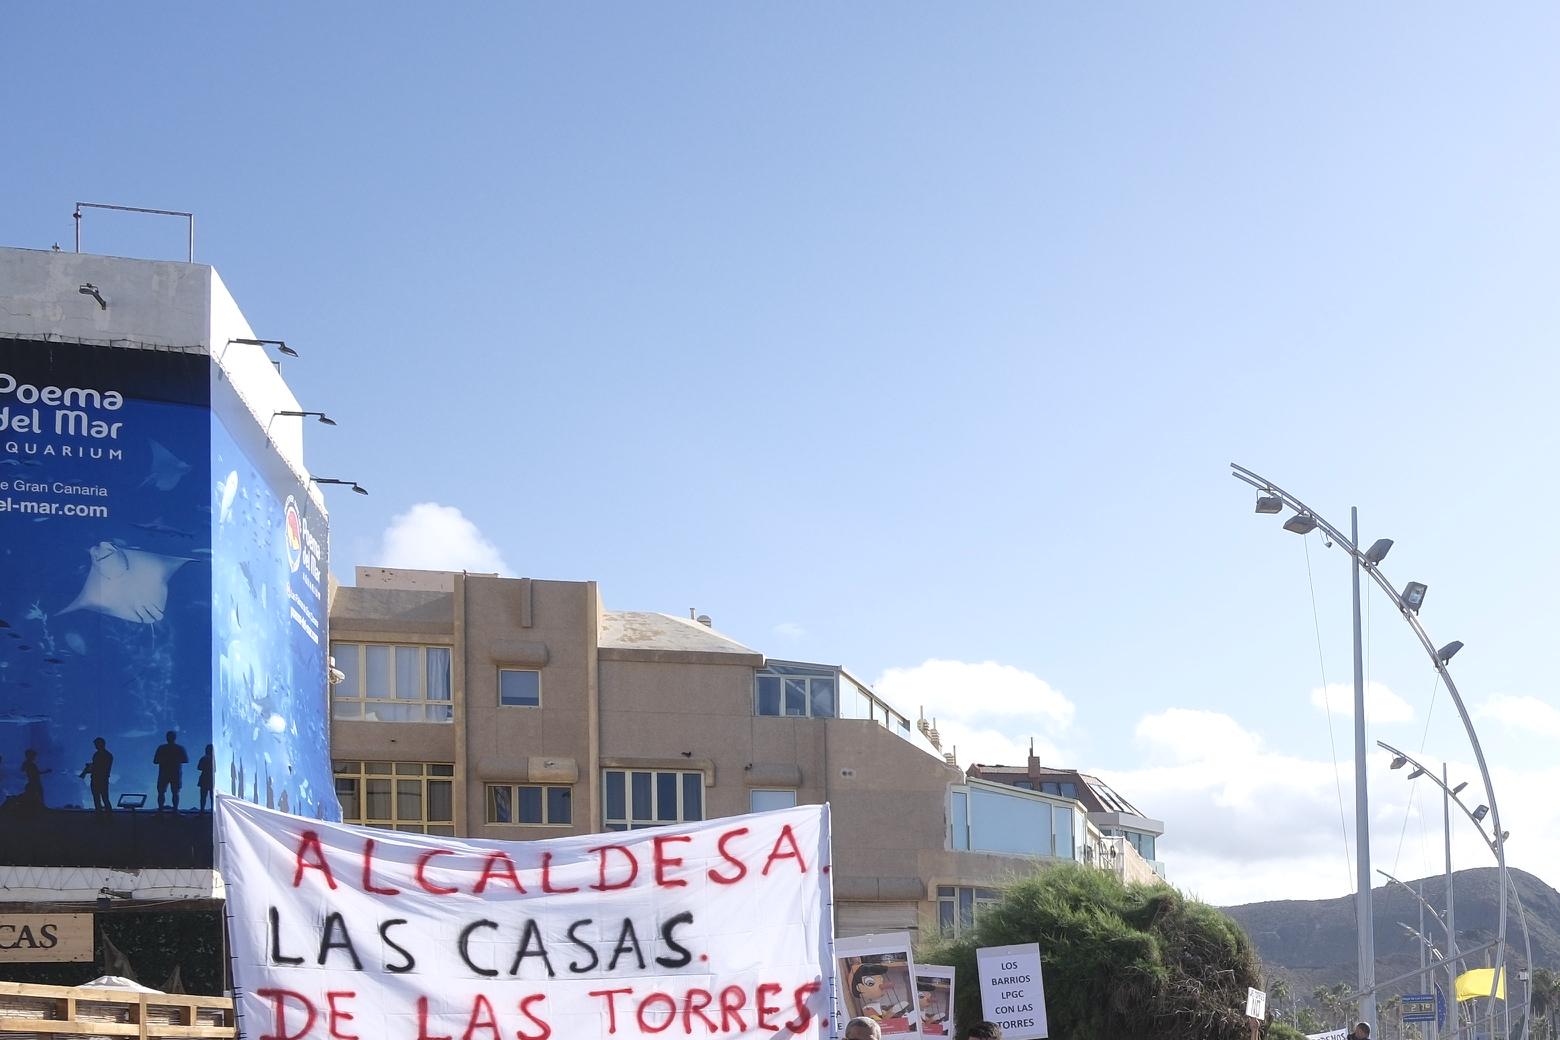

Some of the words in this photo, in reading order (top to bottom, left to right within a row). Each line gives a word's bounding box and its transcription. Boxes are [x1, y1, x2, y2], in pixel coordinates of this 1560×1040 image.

[55, 410, 123, 439] Mar
[14, 480, 48, 493] Gran
[53, 483, 108, 497] Canaria
[270, 906, 415, 972] LAS
[1001, 962, 1018, 970] LOS
[991, 975, 1031, 986] BARRIOS
[1001, 990, 1024, 1000] LPGC
[995, 1006, 1015, 1014] CON
[1017, 1004, 1033, 1012] LAS
[997, 1018, 1035, 1029] TORRES
